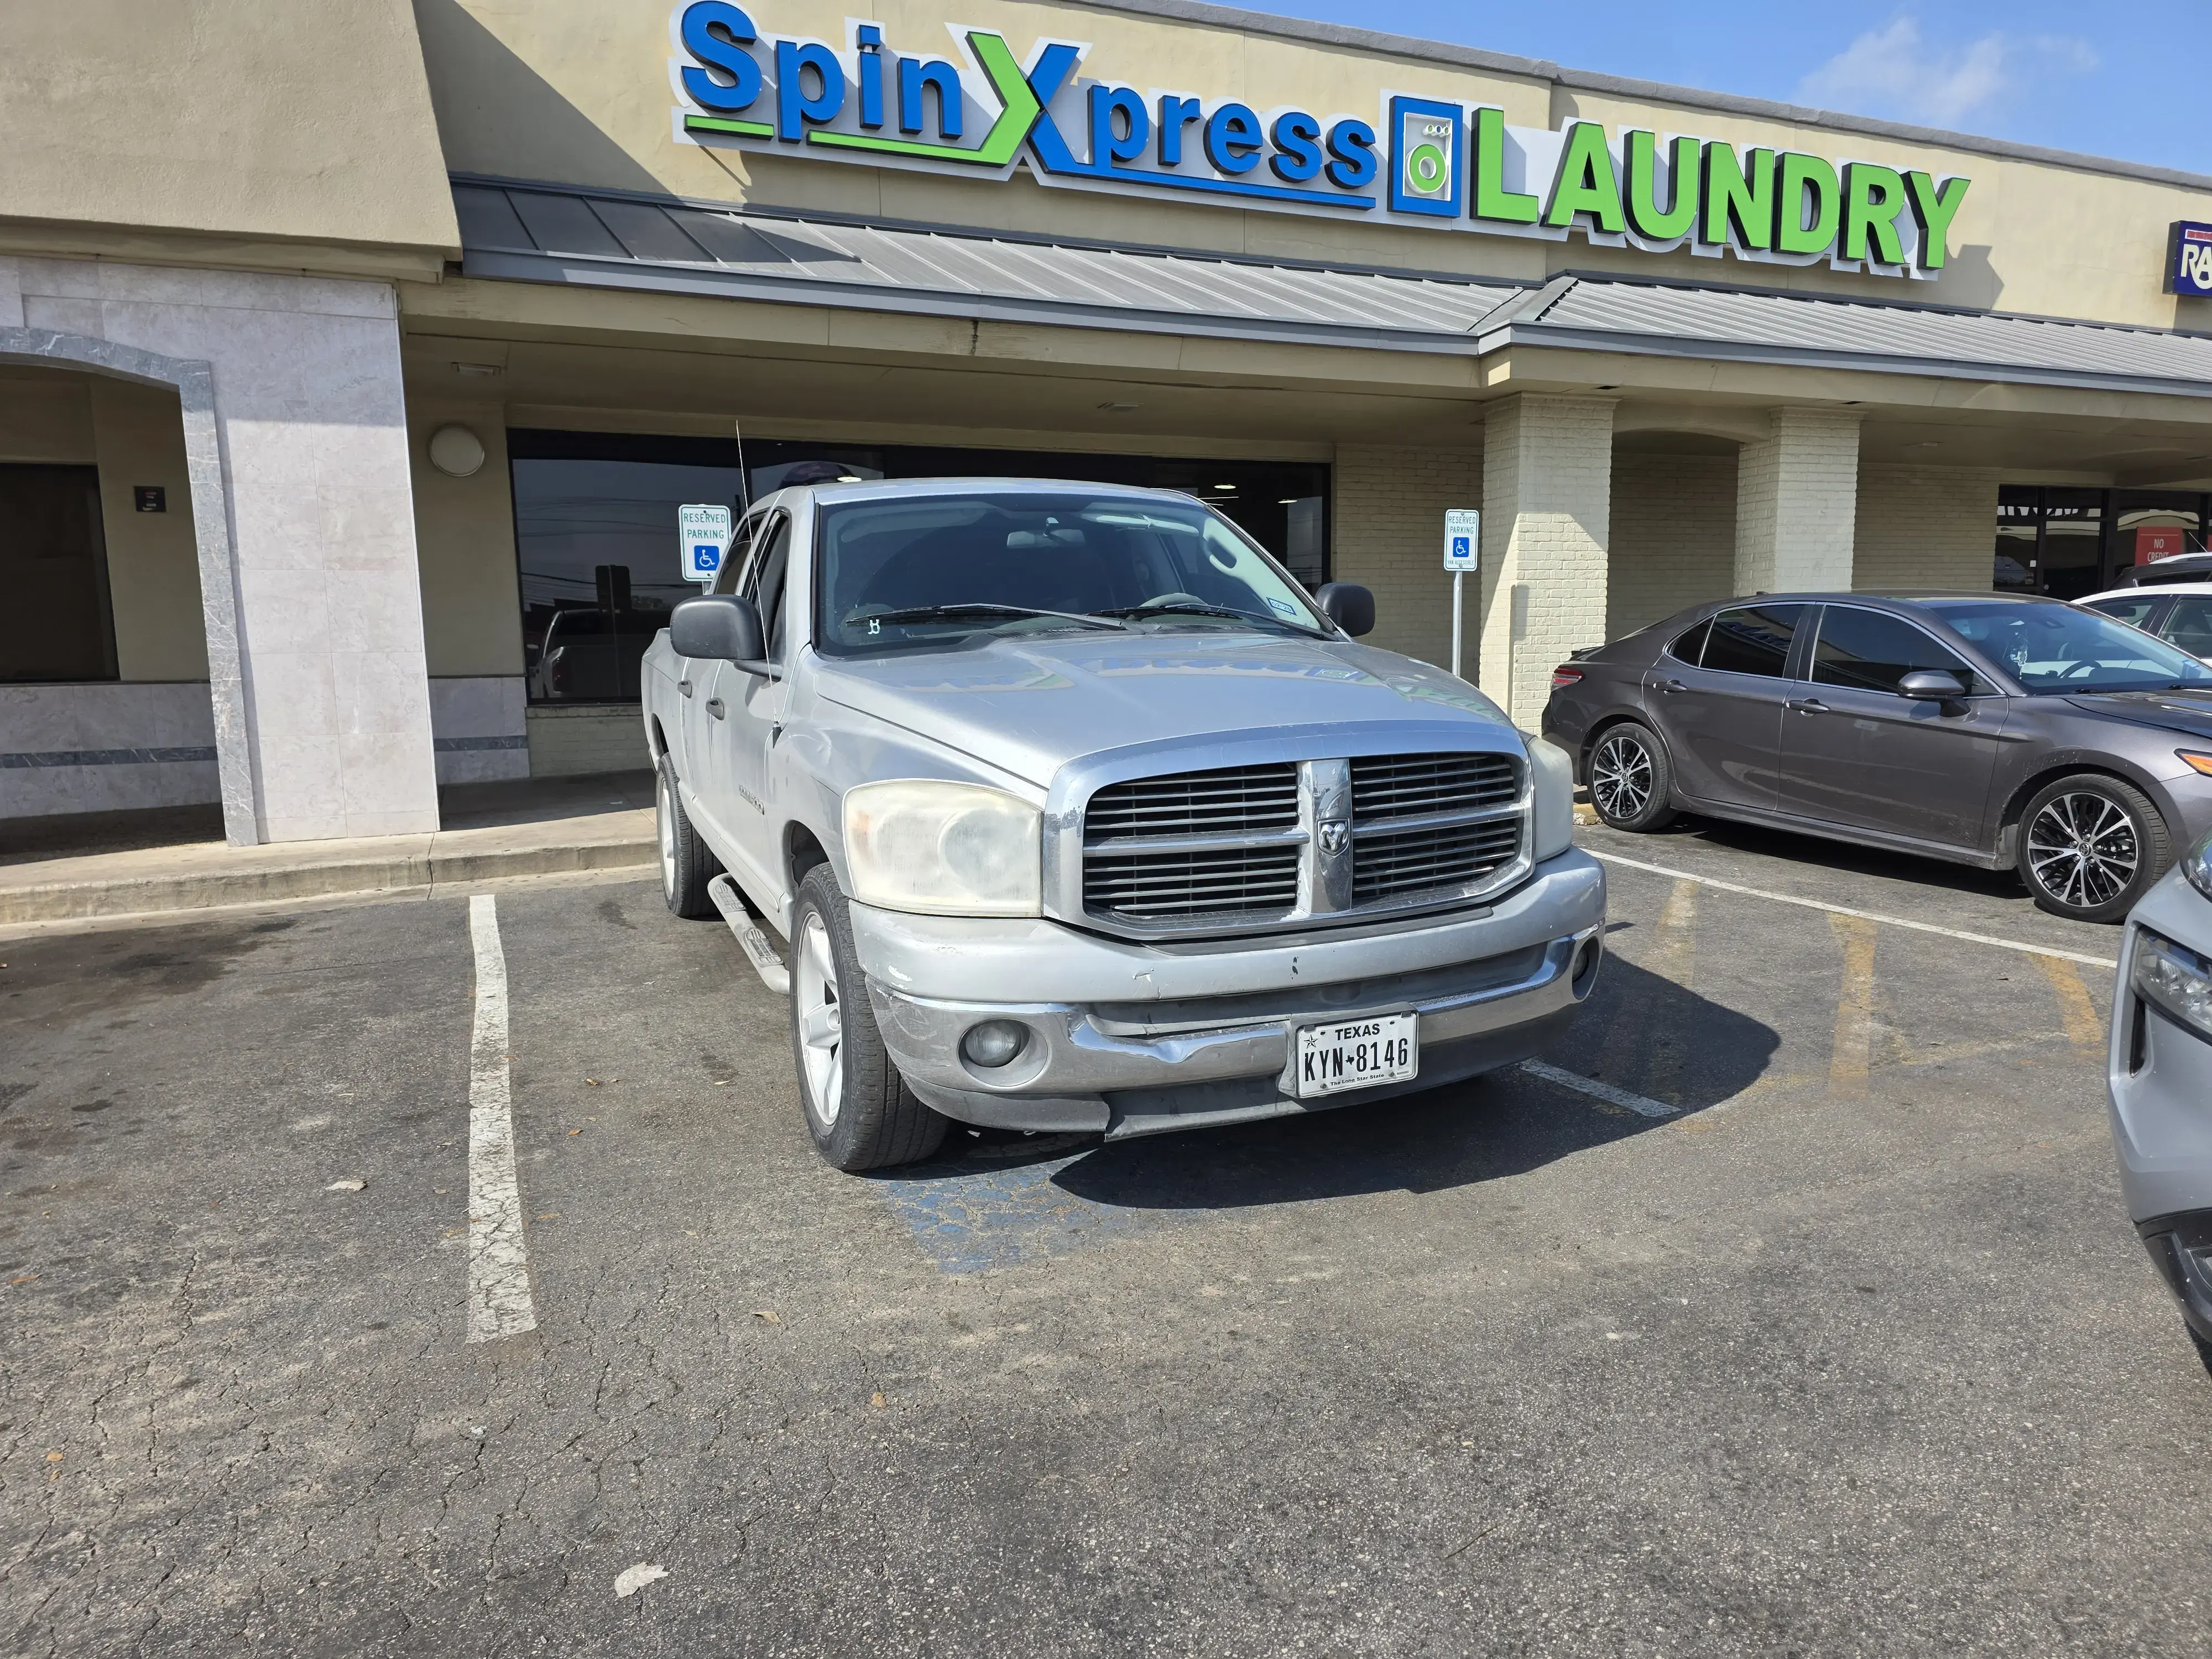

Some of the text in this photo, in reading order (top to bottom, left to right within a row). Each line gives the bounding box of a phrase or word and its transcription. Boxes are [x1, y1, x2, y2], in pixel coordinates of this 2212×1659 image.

[1470, 106, 1971, 271] LAUNDRY
[684, 513, 726, 523] RESERVED
[1448, 516, 1476, 524] RESERVED
[687, 529, 724, 539] PARKING
[1449, 526, 1474, 534] PARKING
[2153, 538, 2164, 549] NO
[1335, 1023, 1380, 1041] TEXAS
